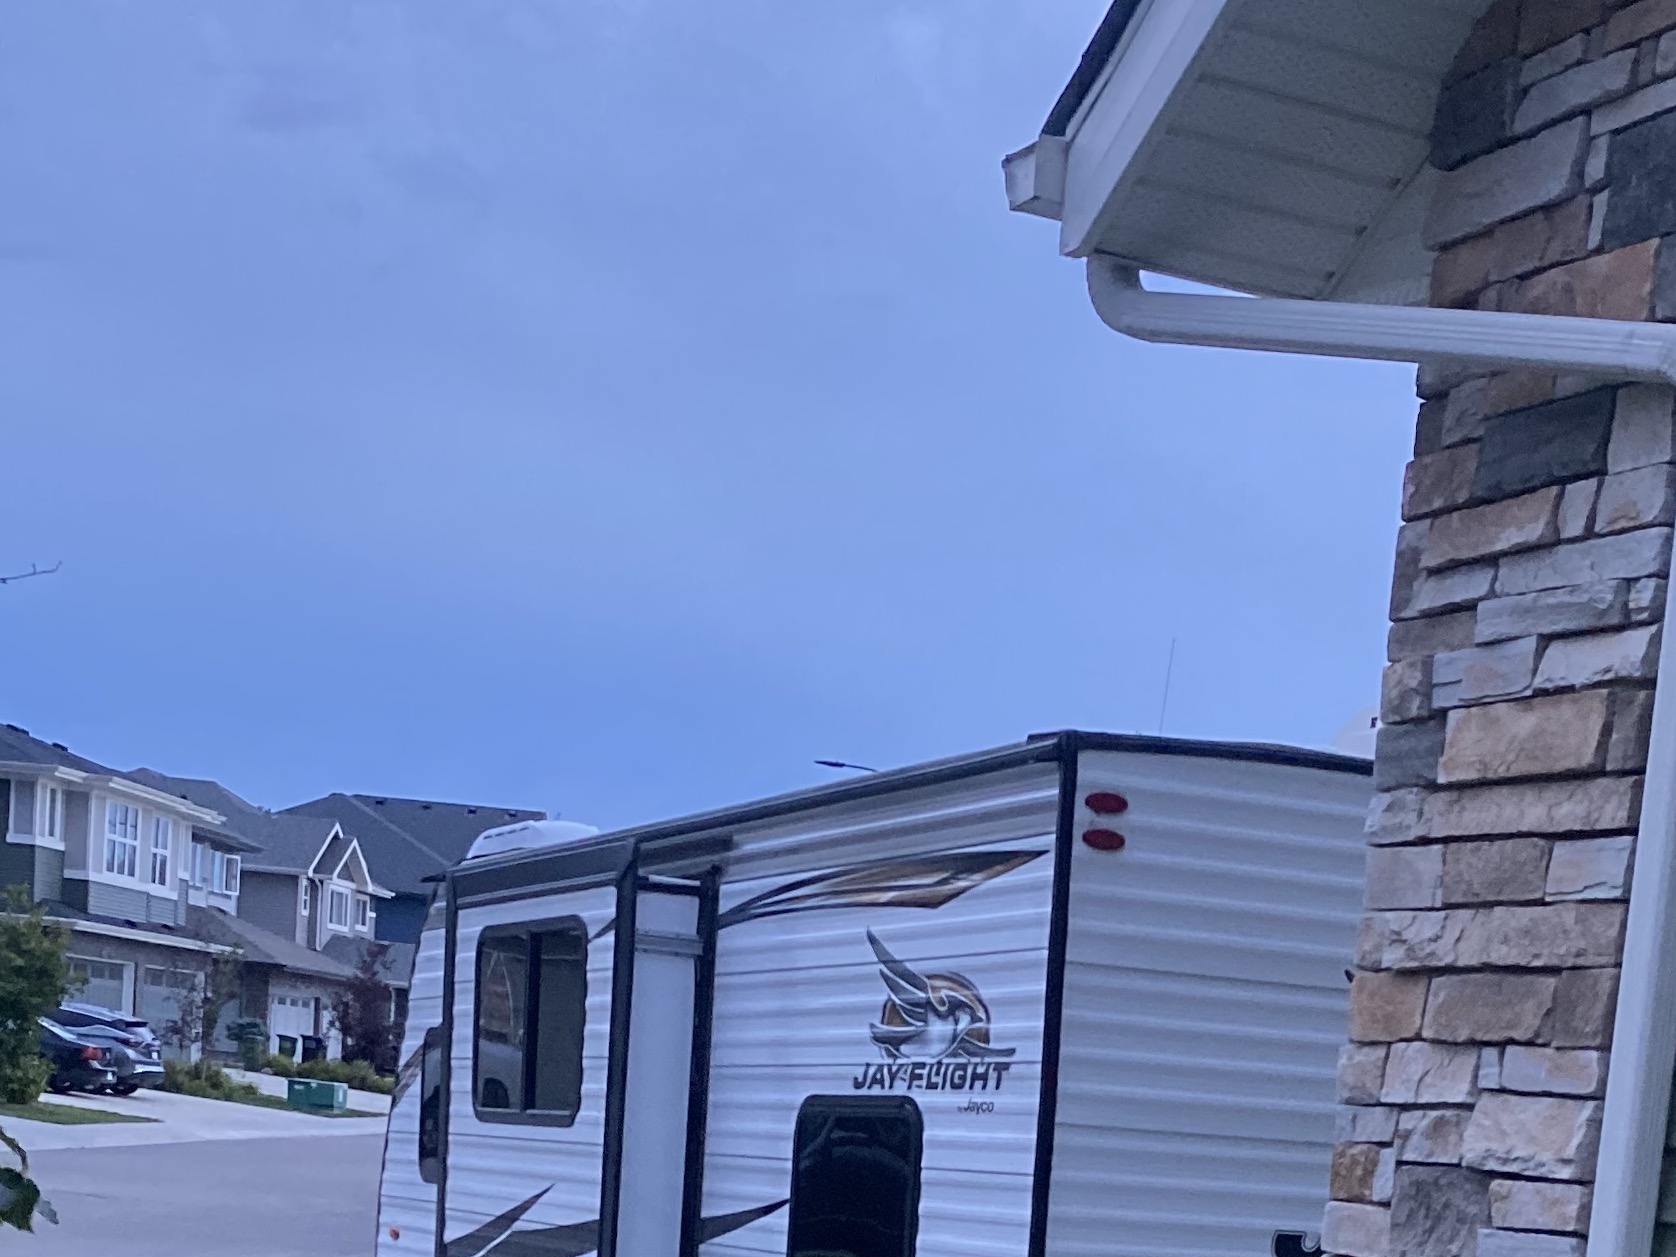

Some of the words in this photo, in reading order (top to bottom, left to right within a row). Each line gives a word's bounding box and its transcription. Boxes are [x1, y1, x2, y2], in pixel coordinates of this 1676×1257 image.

[853, 1062, 903, 1090] JAY
[907, 1061, 1011, 1090] FLIGHT
[963, 1098, 995, 1115] Jayco
